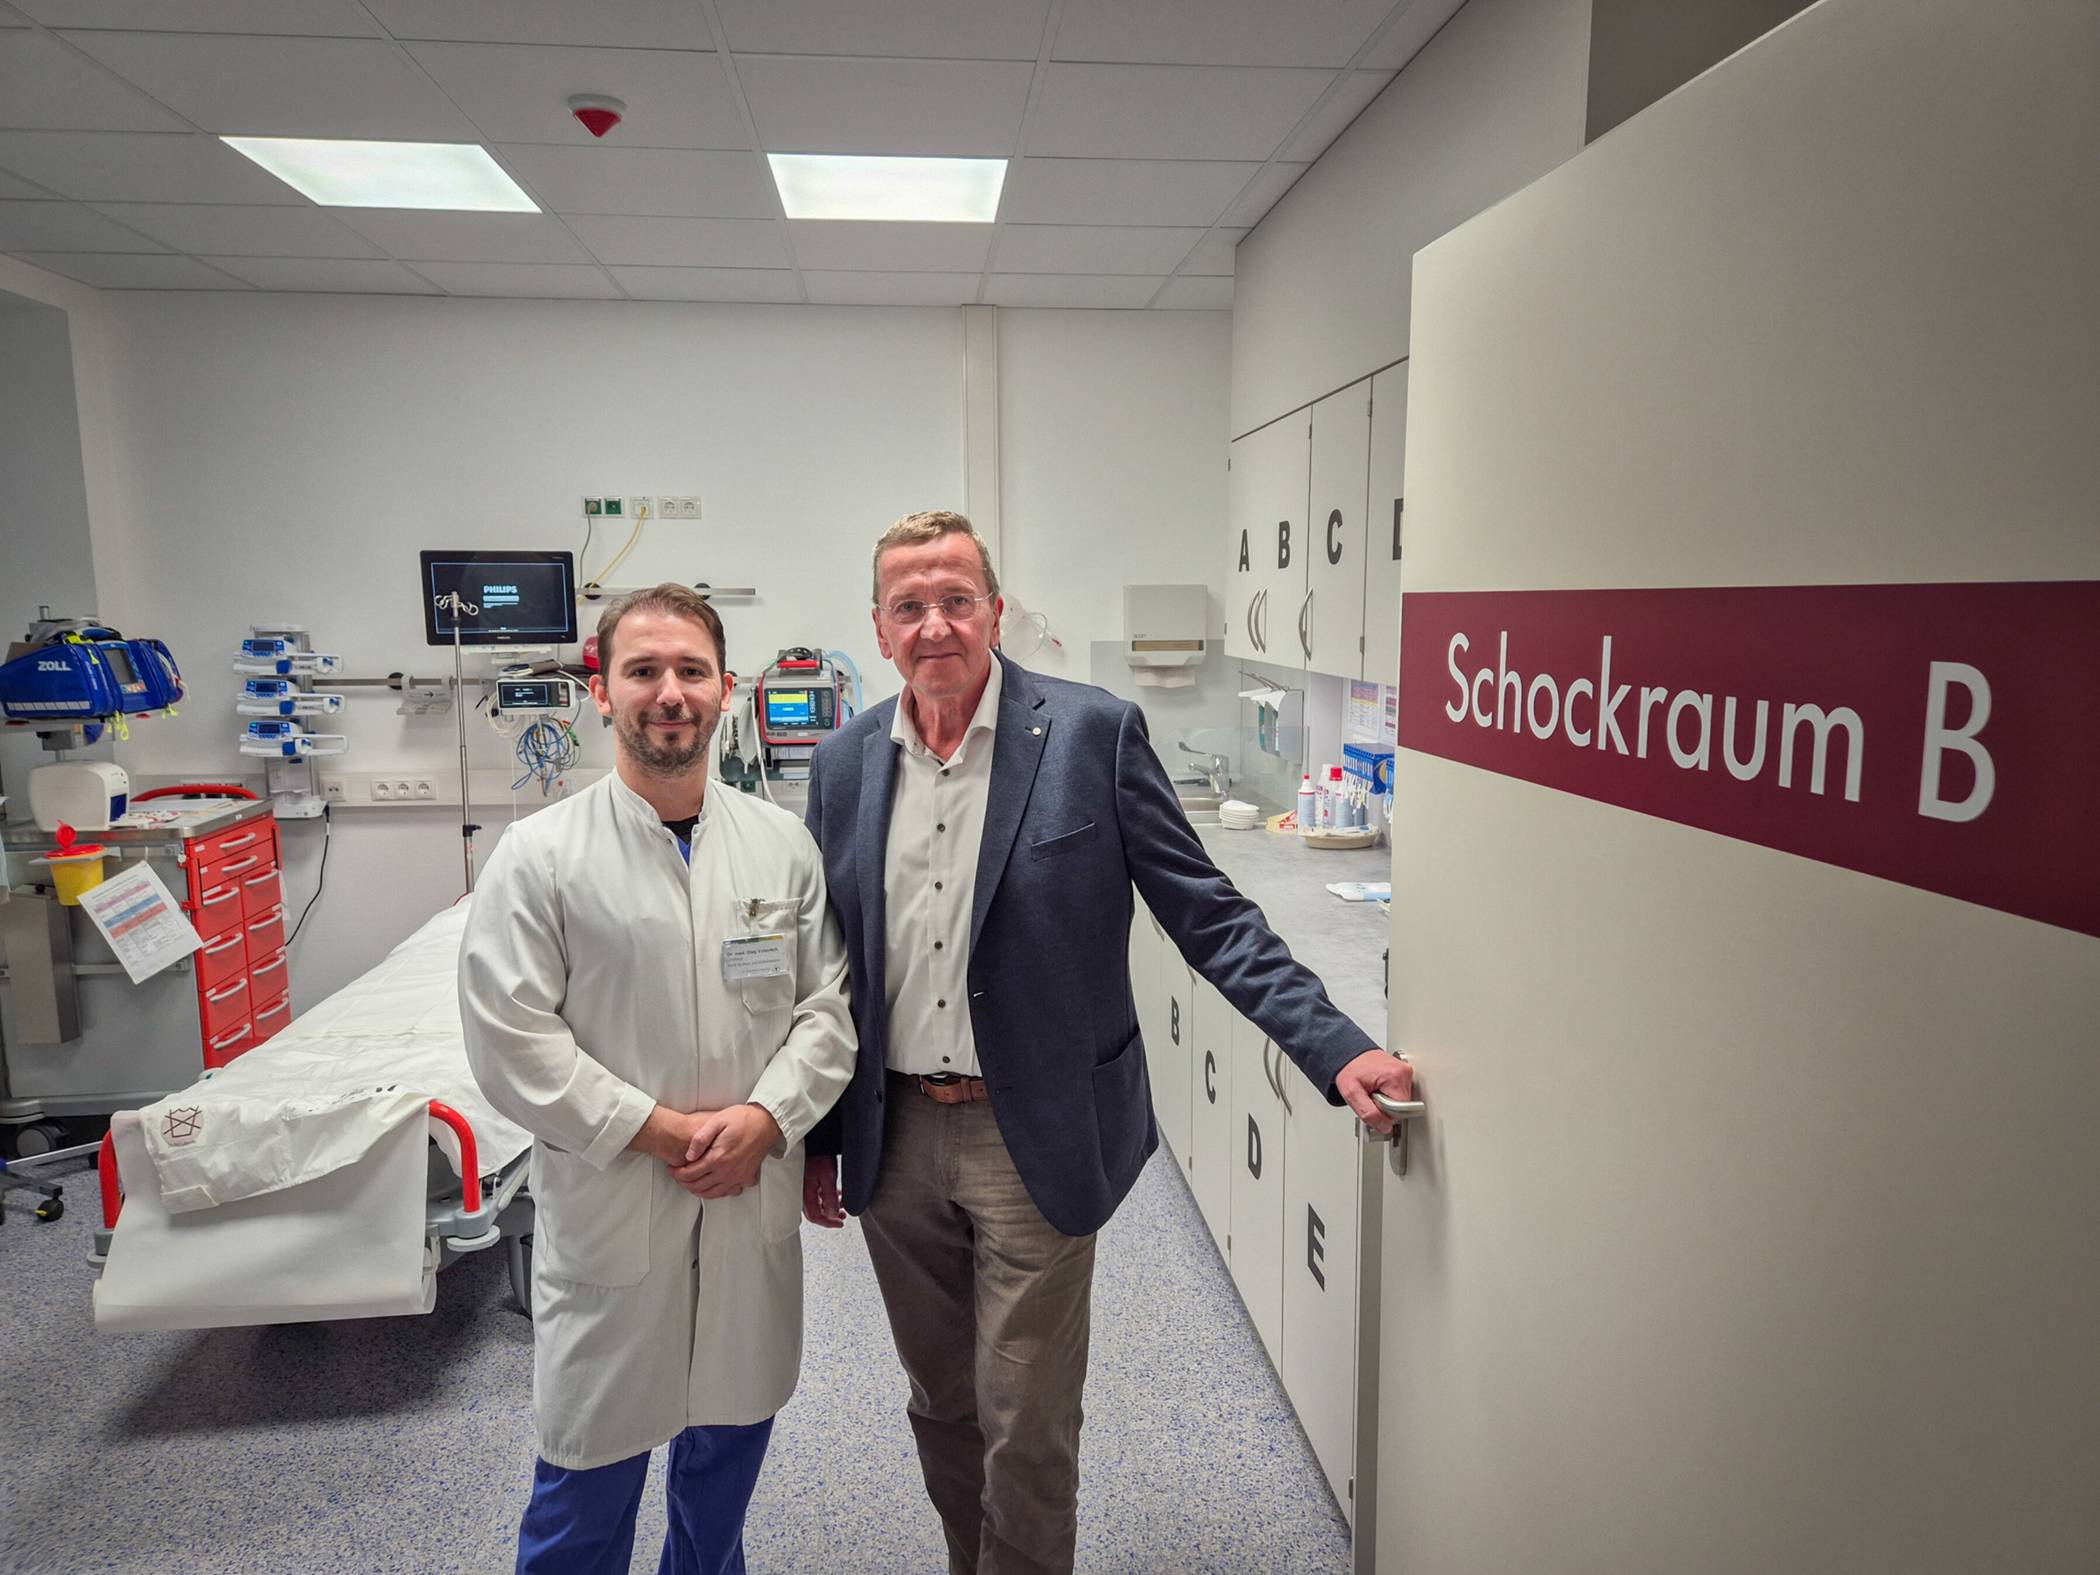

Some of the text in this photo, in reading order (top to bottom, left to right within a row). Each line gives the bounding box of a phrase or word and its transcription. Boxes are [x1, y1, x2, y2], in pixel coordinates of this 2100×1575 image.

[1238, 528, 1250, 573] A
[1278, 520, 1291, 570] B
[1326, 508, 1343, 565] C
[483, 585, 518, 594] PHILIPS
[37, 660, 72, 672] ZOLL
[1445, 630, 1996, 823] Schockraum B
[1170, 995, 1180, 1047] B
[1204, 1049, 1217, 1105] C
[1247, 1113, 1262, 1180] D
[1307, 1202, 1326, 1292] E
